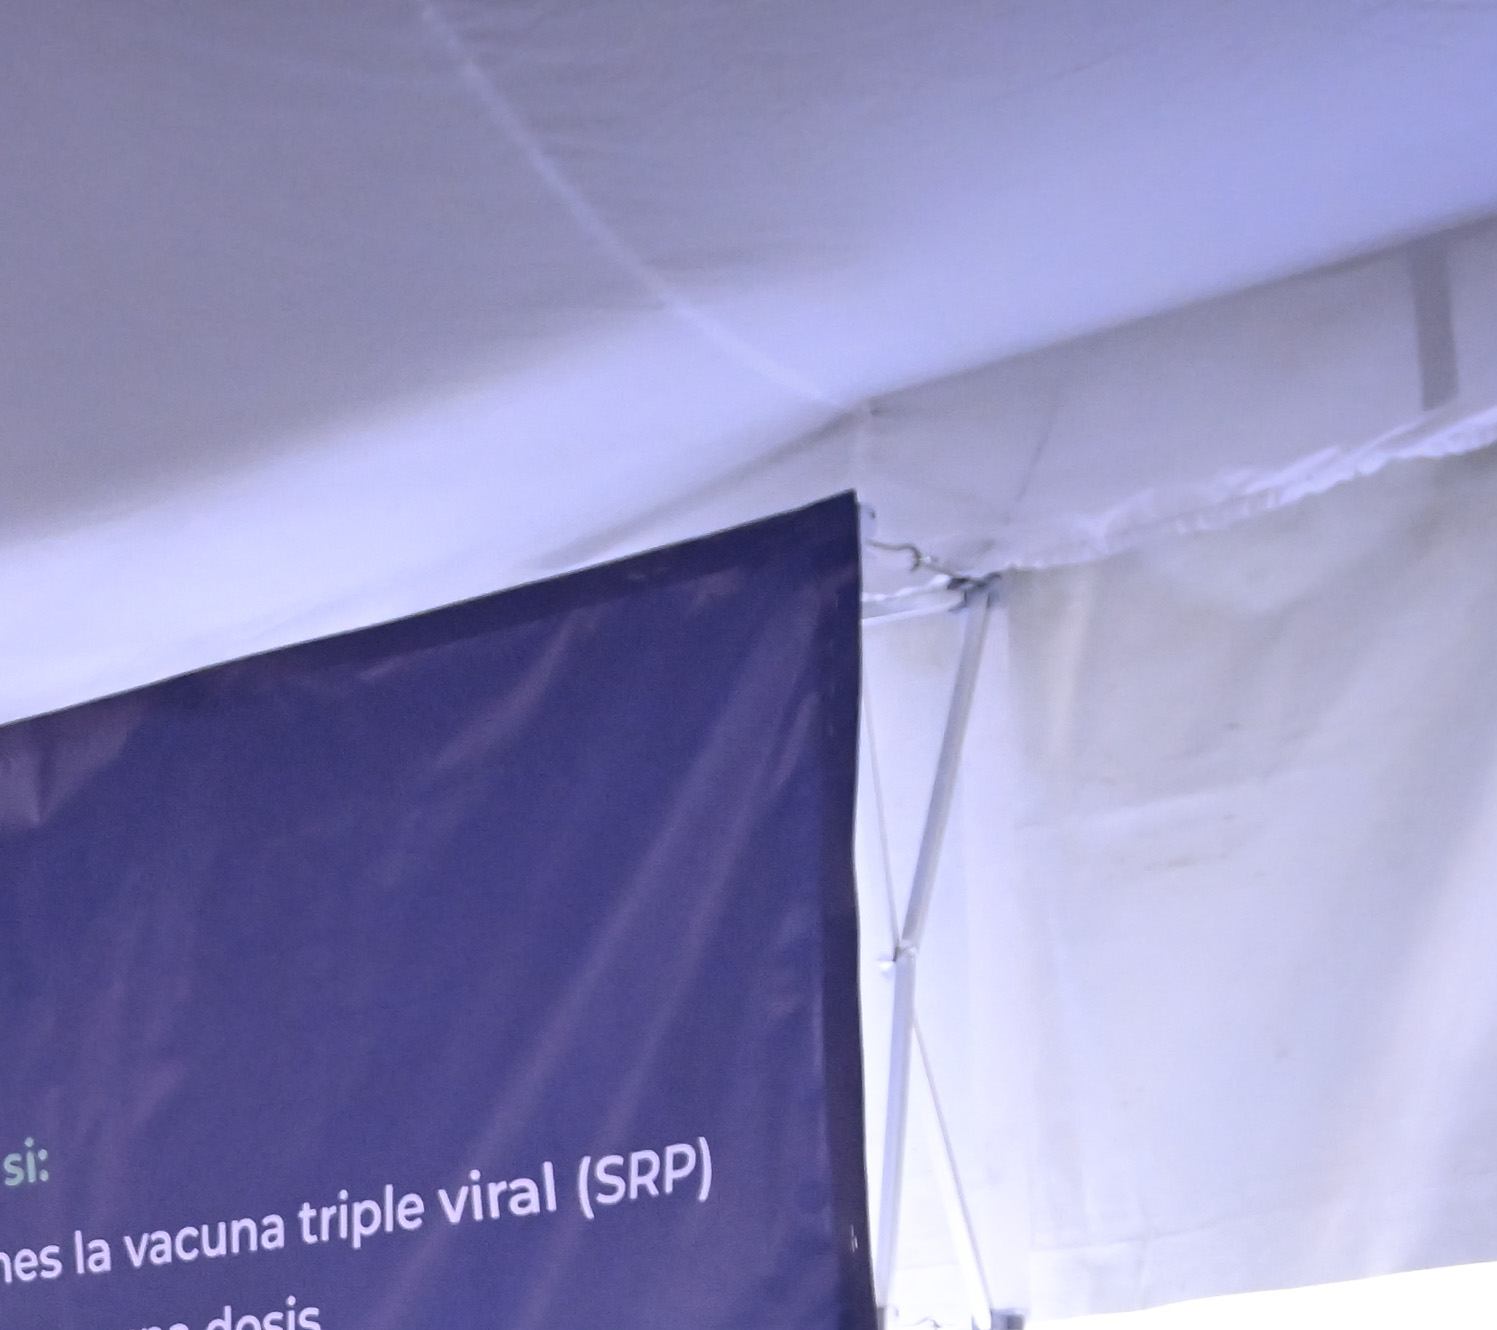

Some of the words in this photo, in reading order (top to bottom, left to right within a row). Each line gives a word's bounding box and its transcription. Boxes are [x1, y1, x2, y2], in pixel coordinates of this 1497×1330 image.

[3, 1137, 50, 1187] si:
[75, 1229, 111, 1276] la
[124, 1214, 284, 1269] vacuna
[298, 1182, 424, 1251] triple
[437, 1160, 557, 1228] viral
[577, 1136, 715, 1218] (SRP)
